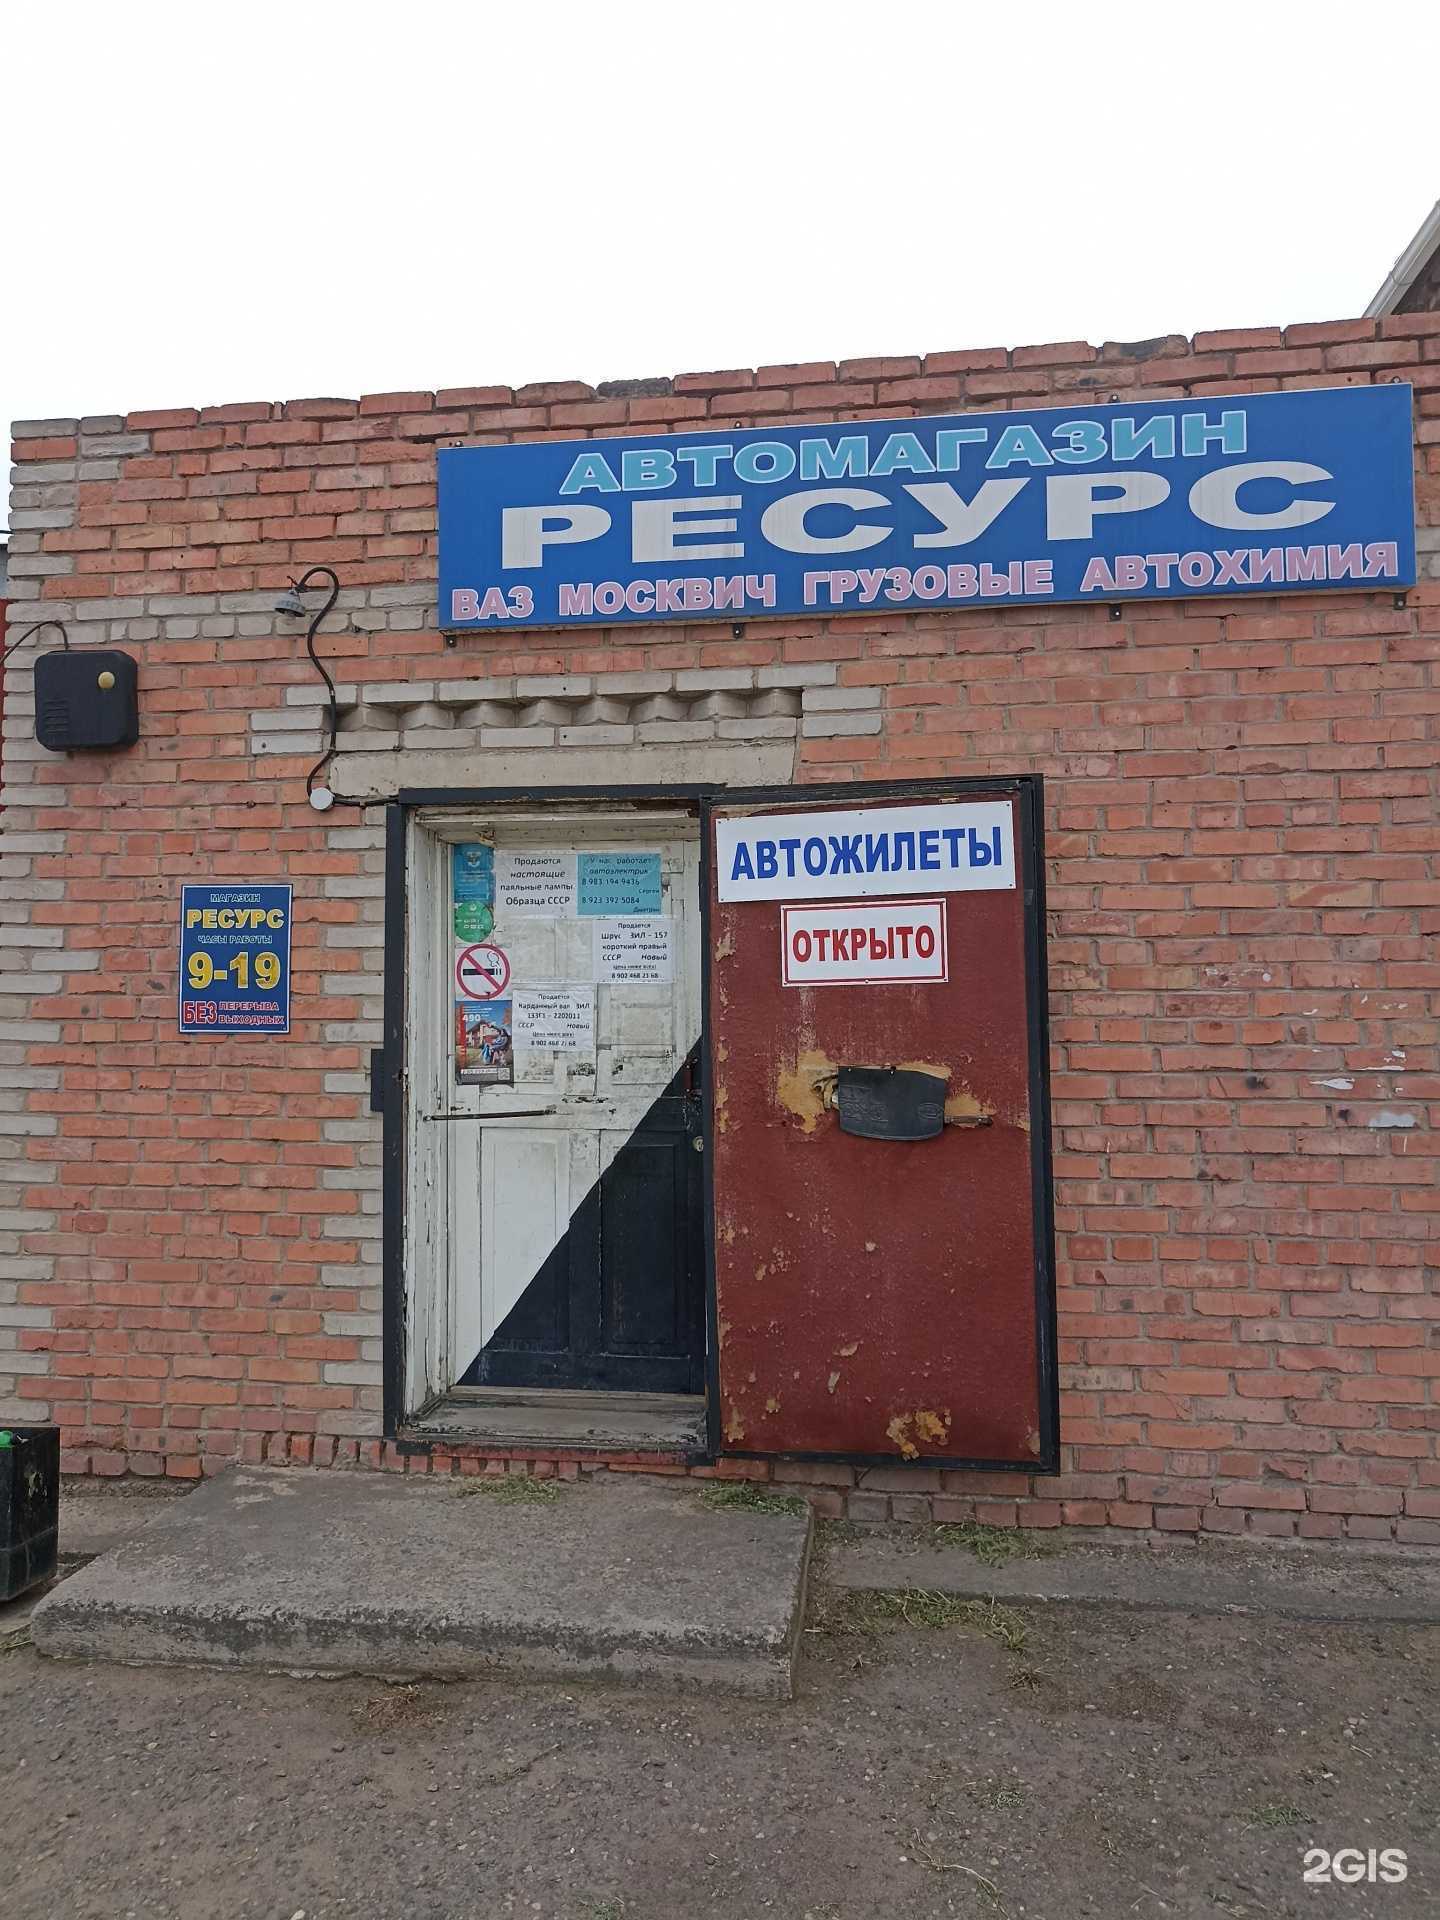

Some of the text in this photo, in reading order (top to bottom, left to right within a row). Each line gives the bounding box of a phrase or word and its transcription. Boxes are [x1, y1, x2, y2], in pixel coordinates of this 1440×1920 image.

[558, 410, 1248, 495] АВТОМАГАЗИН
[502, 461, 1337, 569] РЕСУРС
[451, 542, 1398, 621] ВАЗ МОСКВИЧ ГРУЗОВЫЕ АВТОХИМИЯ
[731, 826, 1002, 881] АВТОЖИЛЕТЫ
[514, 858, 561, 866] Продаются
[210, 893, 261, 903] МАГАЗИН
[505, 896, 570, 906] Образца СССР
[186, 908, 285, 929] РЕСУРС
[197, 935, 273, 944] ЧАСЫ РАБОТЫ
[630, 931, 646, 939] ЗИЛ
[654, 931, 668, 939] 157
[602, 942, 667, 951] короткий правый
[792, 925, 935, 963] ОТКРЫТО
[602, 953, 622, 961] СССР
[187, 951, 281, 990] 9-19
[183, 1000, 280, 1024] БЕЗ ПЕРЕРЫВА
[218, 1015, 285, 1026] ВЫХОДНЫХ
[463, 1014, 481, 1022] 490
